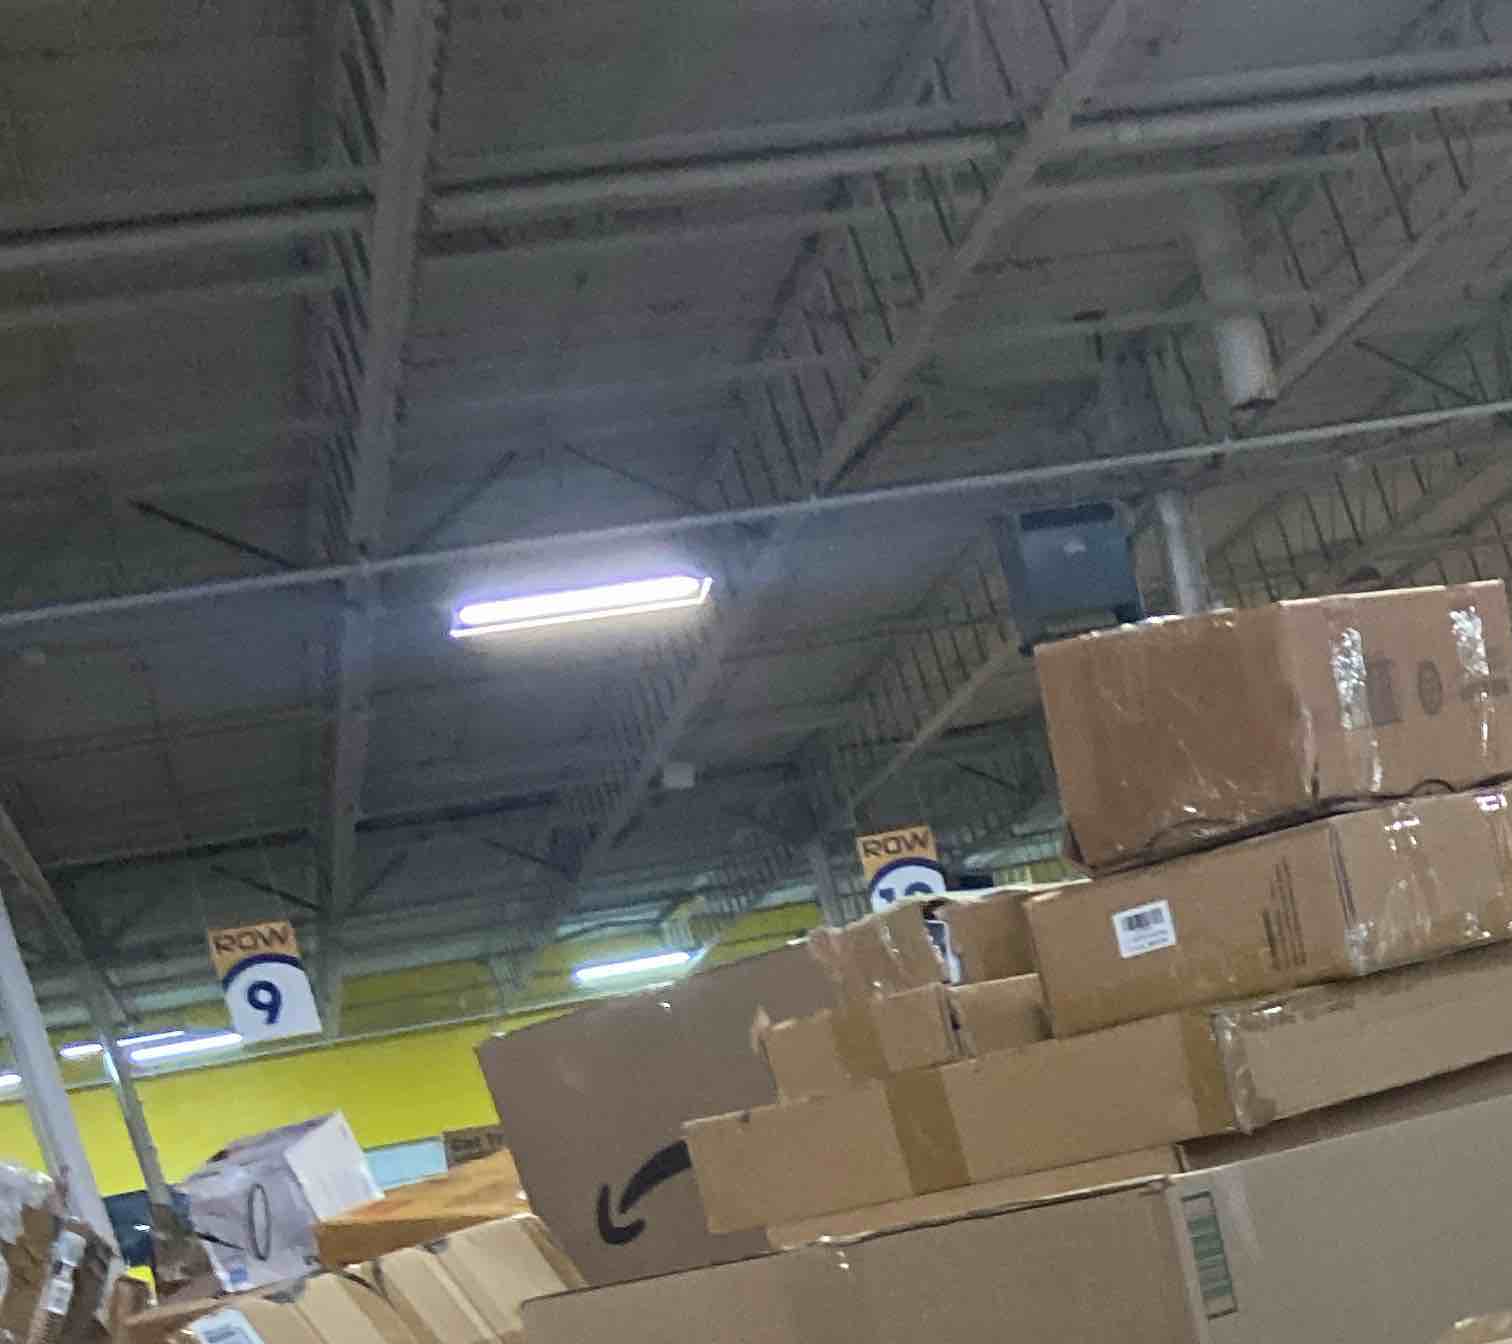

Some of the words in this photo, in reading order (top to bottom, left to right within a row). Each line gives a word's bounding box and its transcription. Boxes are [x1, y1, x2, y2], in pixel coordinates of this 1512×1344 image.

[861, 830, 930, 858] ROW
[212, 925, 290, 954] ROW
[246, 980, 283, 1025] 9
